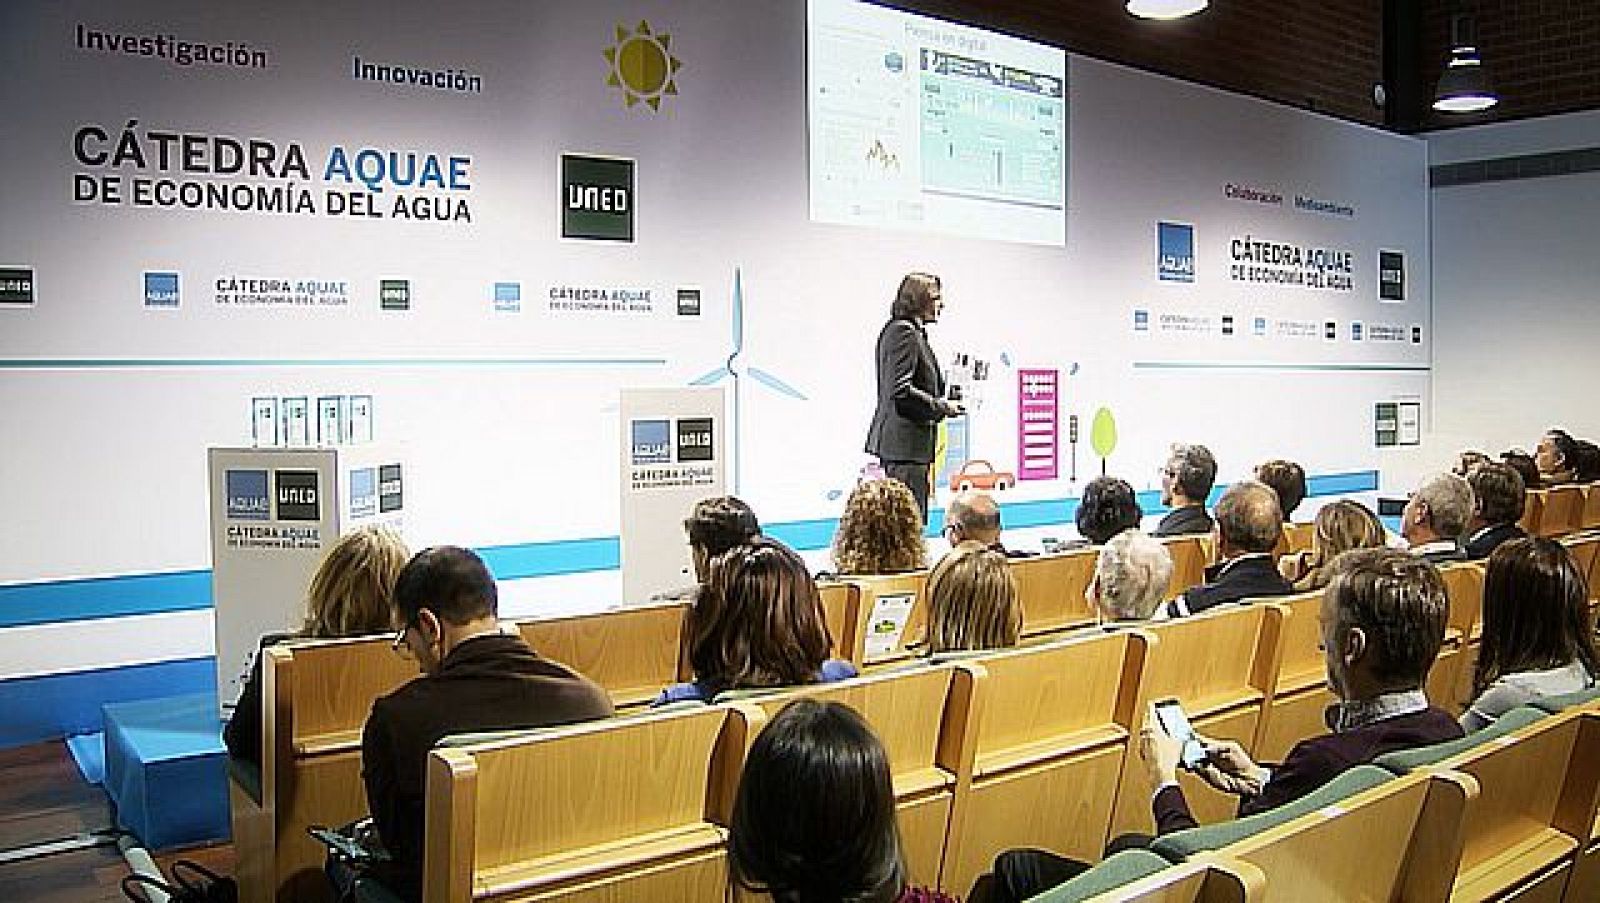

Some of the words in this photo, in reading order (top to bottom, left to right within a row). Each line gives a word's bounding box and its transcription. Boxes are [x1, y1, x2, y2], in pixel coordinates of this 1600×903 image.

[76, 24, 267, 68] Investigación
[353, 57, 482, 93] Innovación
[74, 119, 310, 181] CÁTEDRA
[324, 146, 472, 192] AQUAE
[74, 175, 121, 203] DE
[134, 179, 316, 214] ECONOMÍA
[327, 191, 384, 220] DEL
[391, 195, 472, 223] AGUA
[569, 184, 627, 211] UNED
[1231, 235, 1303, 267] CÁTEDRA
[1305, 249, 1352, 274] AQUAE
[1231, 265, 1246, 281] DE
[216, 275, 291, 293] CÁTEDRA
[295, 281, 348, 297] AQUAE
